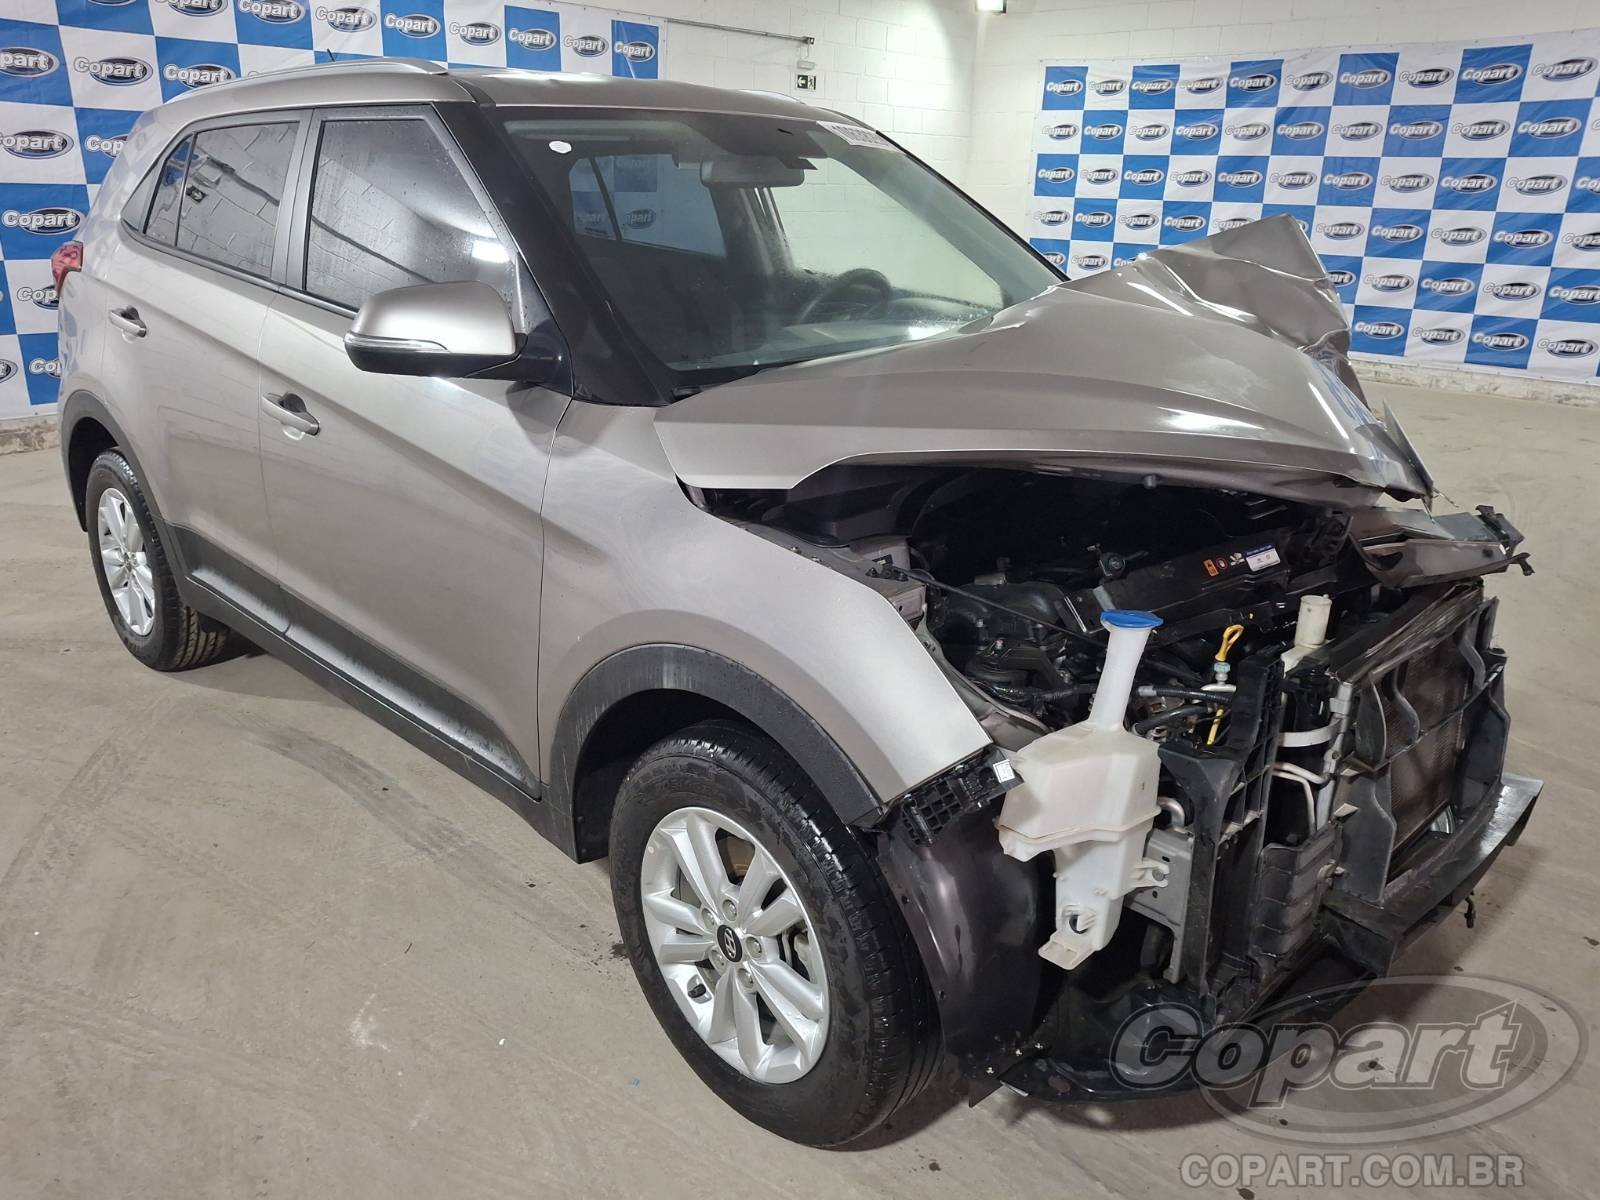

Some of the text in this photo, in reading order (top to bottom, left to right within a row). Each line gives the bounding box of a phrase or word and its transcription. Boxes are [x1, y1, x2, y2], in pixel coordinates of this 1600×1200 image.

[239, 0, 298, 17] Copart
[316, 6, 368, 25] Copart
[385, 13, 434, 32] Copart
[449, 22, 496, 39] Copart
[508, 28, 551, 45] Copart
[564, 35, 603, 51] Copart
[614, 41, 651, 57] Copart
[0, 53, 49, 70] part
[74, 56, 143, 79] Copart
[1531, 61, 1592, 79] Copart
[163, 64, 229, 86] Copart
[1229, 76, 1272, 90] Copart
[1284, 72, 1327, 90] Copart
[1339, 69, 1386, 87] Copart
[1399, 69, 1449, 86] Copart
[1461, 65, 1519, 84] Copart
[1046, 81, 1080, 92] Copart
[1131, 80, 1171, 91] Copart
[1083, 125, 1120, 137] Copart
[1128, 125, 1167, 137] Copart
[1175, 125, 1215, 137] Copart
[1224, 124, 1266, 137] Copart
[1277, 123, 1321, 137] Copart
[1331, 121, 1379, 138] Copart
[1389, 121, 1438, 139] Copart
[1452, 121, 1504, 138] Copart
[1516, 117, 1577, 138] Copart
[0, 131, 63, 152] opart
[85, 135, 124, 156] Cop
[1037, 168, 1072, 180] Copart
[1080, 169, 1114, 181] Copart
[1123, 169, 1160, 182] Copart
[1169, 171, 1205, 184] Copart
[1217, 171, 1258, 184] Copart
[1269, 172, 1312, 186] Copart
[1323, 173, 1368, 188] Copart
[1380, 174, 1428, 190] Copart
[1440, 173, 1491, 191] Copart
[1506, 175, 1560, 193] Copart
[2, 210, 77, 230] Copart
[1074, 212, 1110, 224] Copart
[1118, 214, 1155, 226] Copart
[1164, 215, 1202, 228] Copart
[1316, 222, 1360, 238] Copart
[1371, 224, 1419, 241] Copart
[1431, 227, 1481, 243] Copart
[1493, 229, 1548, 247] Copart
[1562, 231, 1600, 248] Copa
[1071, 255, 1106, 268] Copart
[1364, 275, 1409, 290] Copart
[1420, 277, 1471, 295] Copart
[1482, 282, 1536, 299] Copart
[17, 286, 59, 304] Cop
[1354, 321, 1399, 337] Copart
[1412, 326, 1460, 344] Copart
[1472, 331, 1524, 350] Copart
[1537, 338, 1591, 356] Copart
